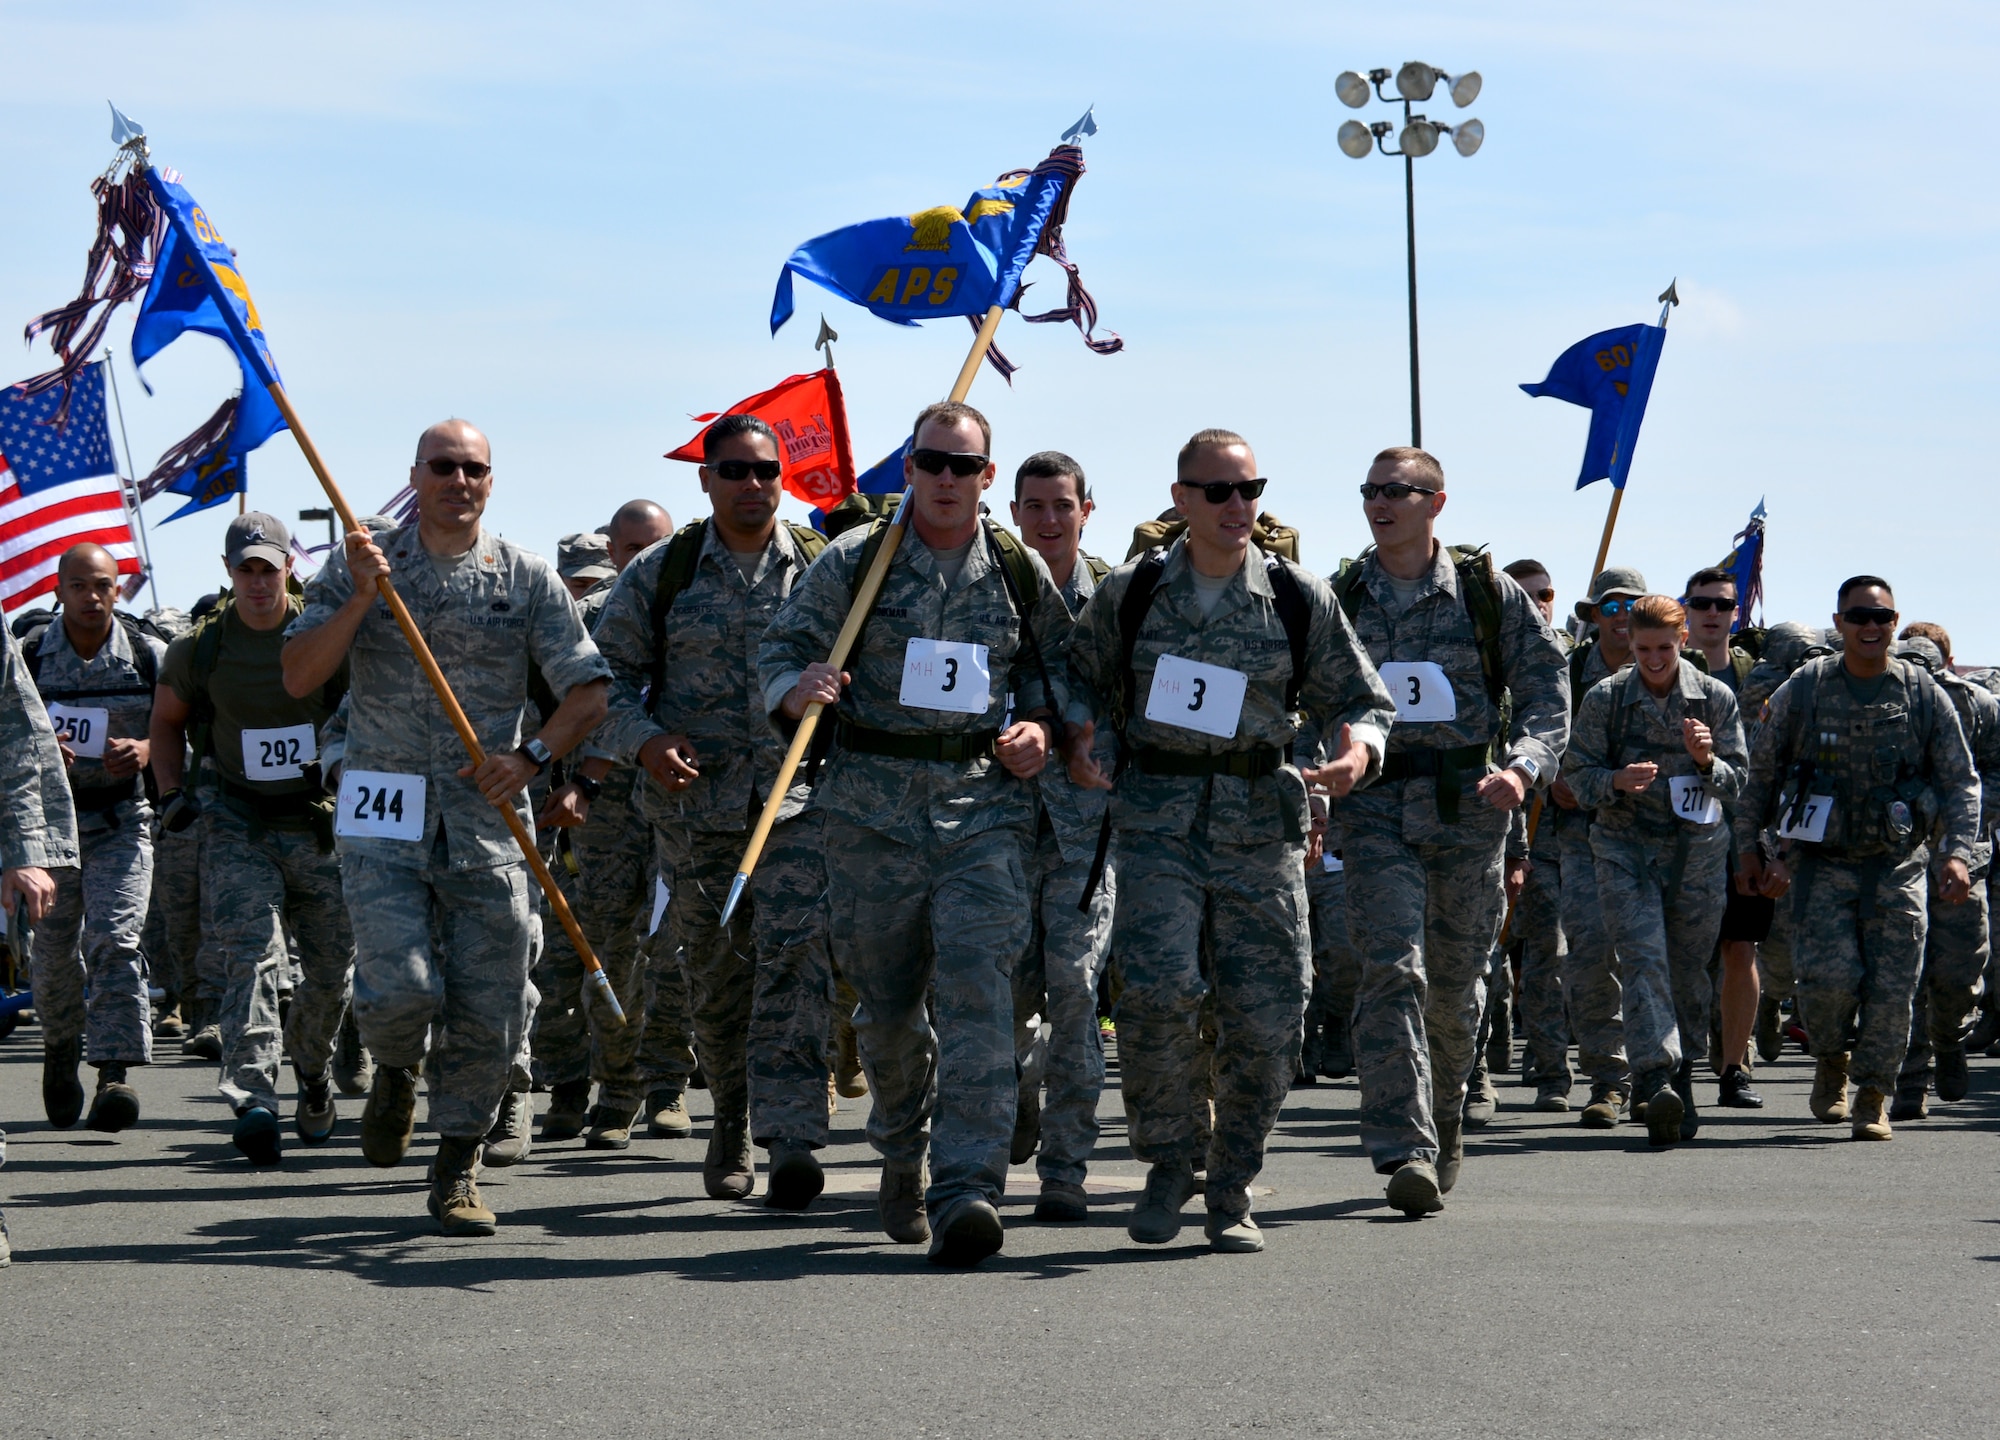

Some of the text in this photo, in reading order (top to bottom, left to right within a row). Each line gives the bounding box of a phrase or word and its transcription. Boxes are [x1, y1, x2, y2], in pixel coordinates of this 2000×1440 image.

[868, 267, 958, 305] APS
[245, 525, 266, 540] A
[486, 616, 501, 626] AIR
[503, 617, 526, 628] FORCE
[876, 607, 908, 618] INKMAN
[995, 615, 1008, 627] AIR
[910, 661, 933, 677] MH
[941, 657, 958, 692] 3
[1158, 679, 1180, 694] MH
[1187, 677, 1206, 711] 3
[1407, 676, 1421, 706] 3
[55, 716, 91, 744] 250
[259, 738, 302, 768] 292
[354, 785, 404, 823] 244
[1682, 785, 1705, 812] 277
